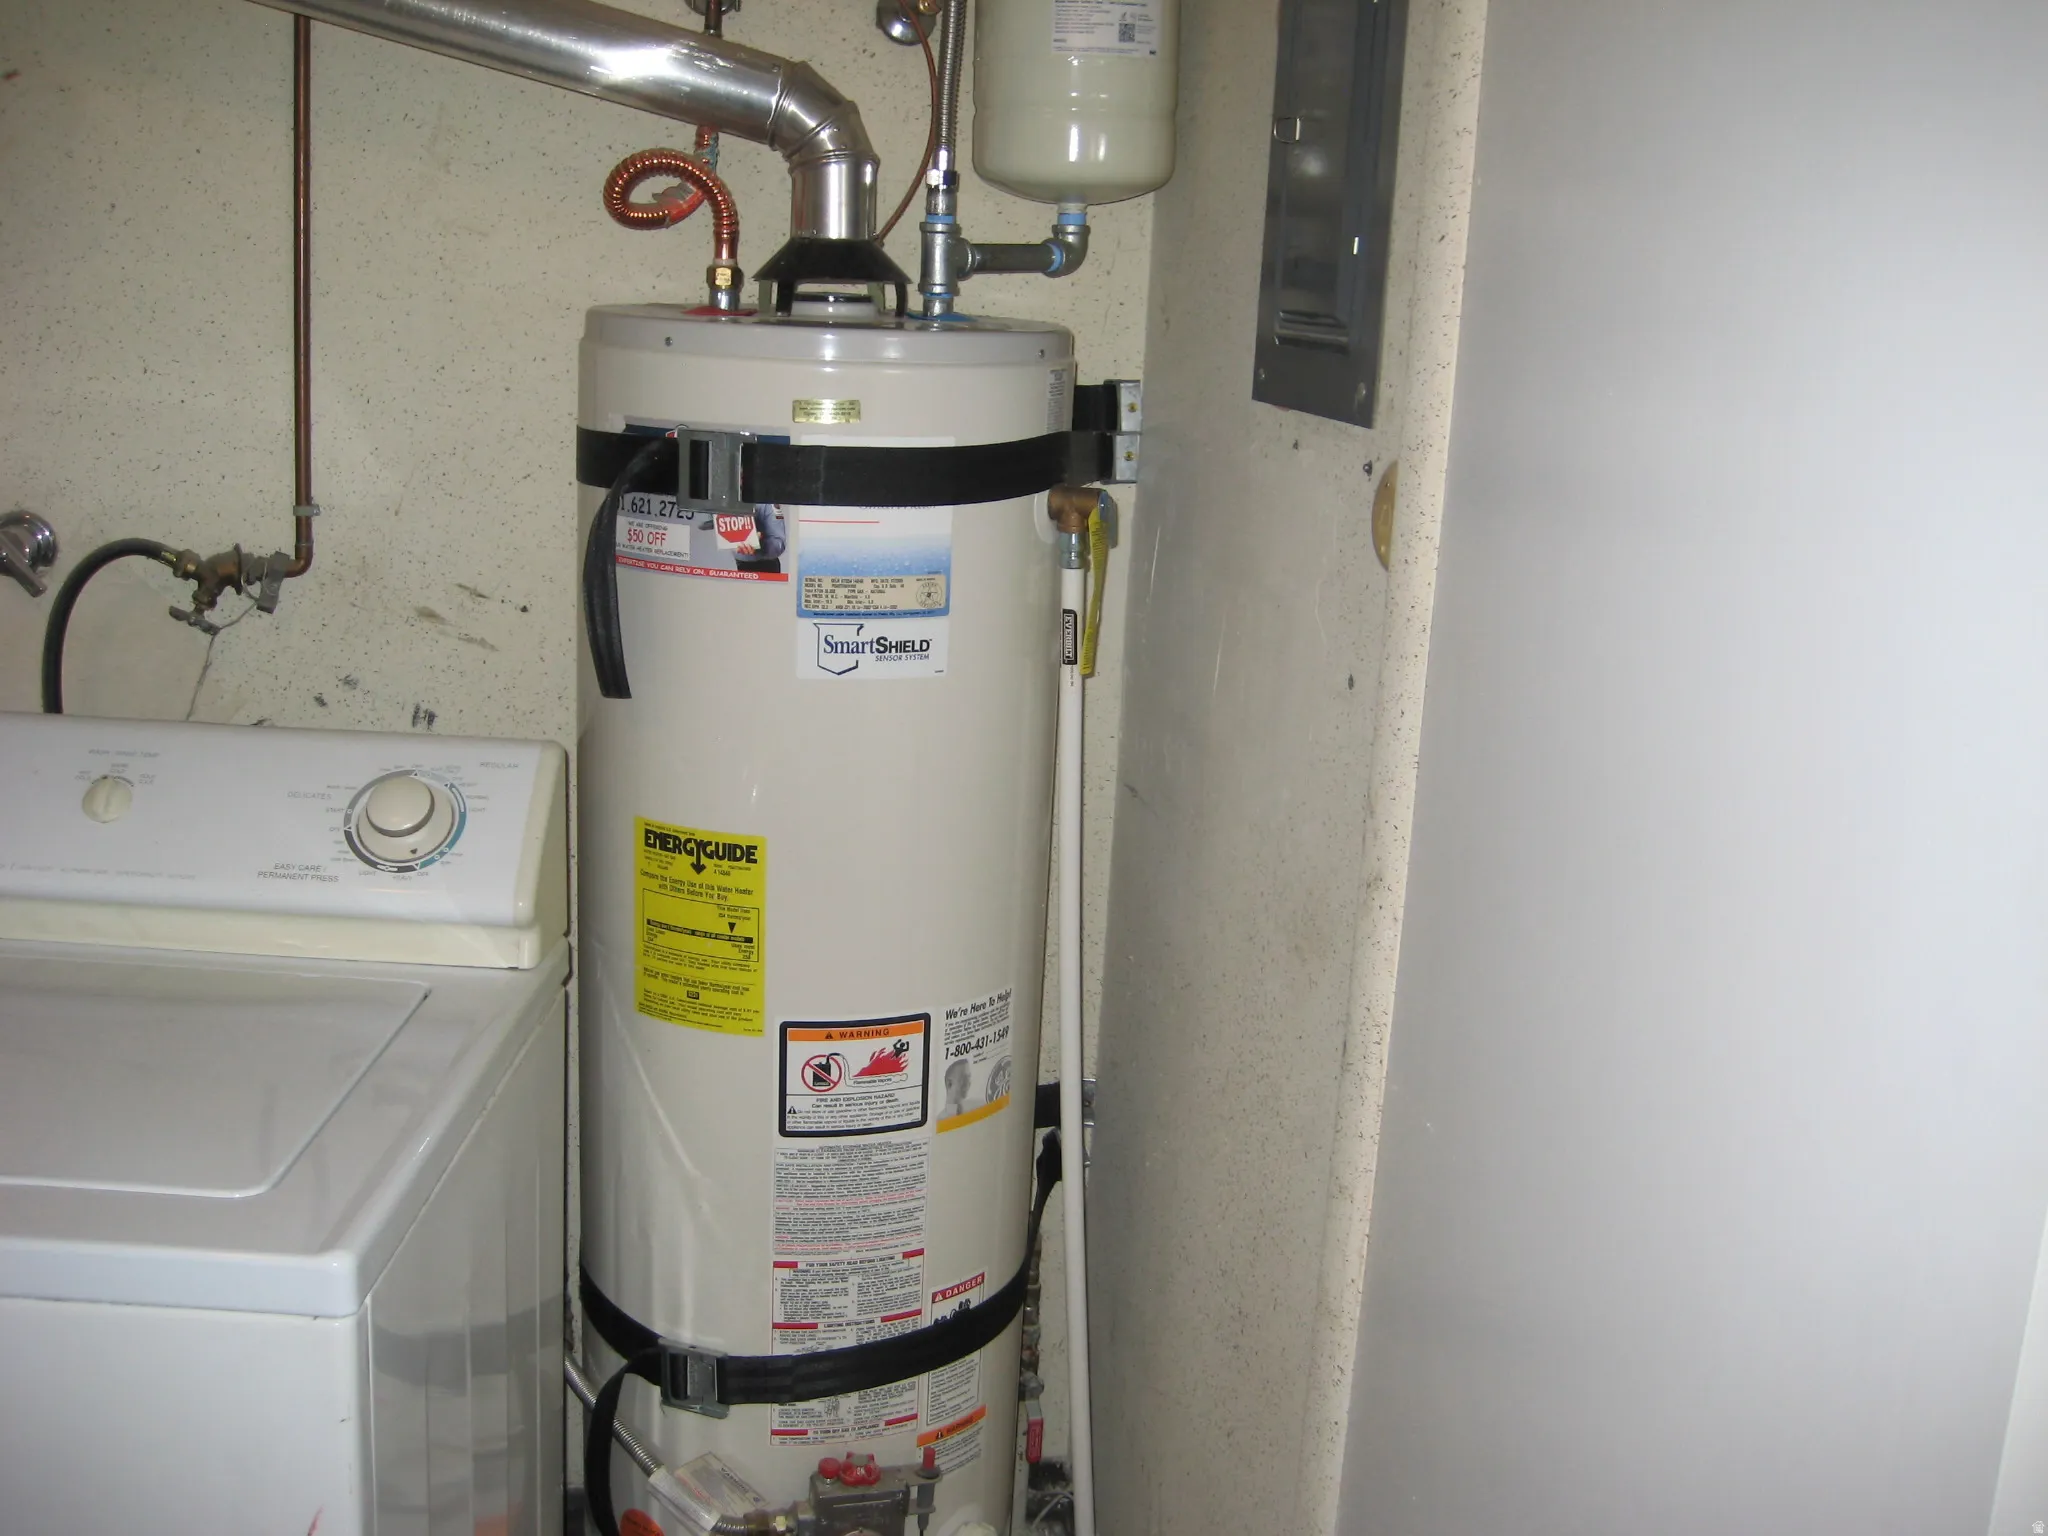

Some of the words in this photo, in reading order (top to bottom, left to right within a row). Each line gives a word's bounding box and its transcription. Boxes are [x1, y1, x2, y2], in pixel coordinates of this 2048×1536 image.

[718, 516, 752, 532] STOP!!
[627, 528, 644, 544] $50
[647, 532, 666, 546] OFF
[647, 562, 658, 570] YOU
[660, 564, 674, 572] CAN
[675, 566, 691, 574] RELY
[709, 570, 759, 580] GUARANTEED
[1065, 616, 1074, 658] EVERBILT
[875, 654, 902, 662] SENSOR
[644, 827, 758, 865] ENERGYGUIDE
[257, 871, 310, 882] PERMANENT
[312, 874, 340, 882] PRESS
[274, 862, 296, 871] EASY
[298, 864, 321, 873] CARE
[640, 869, 658, 880] Compare
[660, 874, 668, 882] the
[669, 876, 686, 886] Energy
[687, 880, 696, 888] Use
[705, 882, 714, 890] this
[716, 885, 733, 894] Water
[735, 886, 754, 895] Heater
[670, 884, 684, 894] Others
[686, 888, 704, 898] Before
[945, 1007, 968, 1020] We're
[970, 1003, 986, 1014] Here
[988, 996, 996, 1007] To
[840, 1028, 890, 1038] WARNING
[945, 1025, 1010, 1060] 1-800-431-1549
[946, 1276, 982, 1298] DANGER
